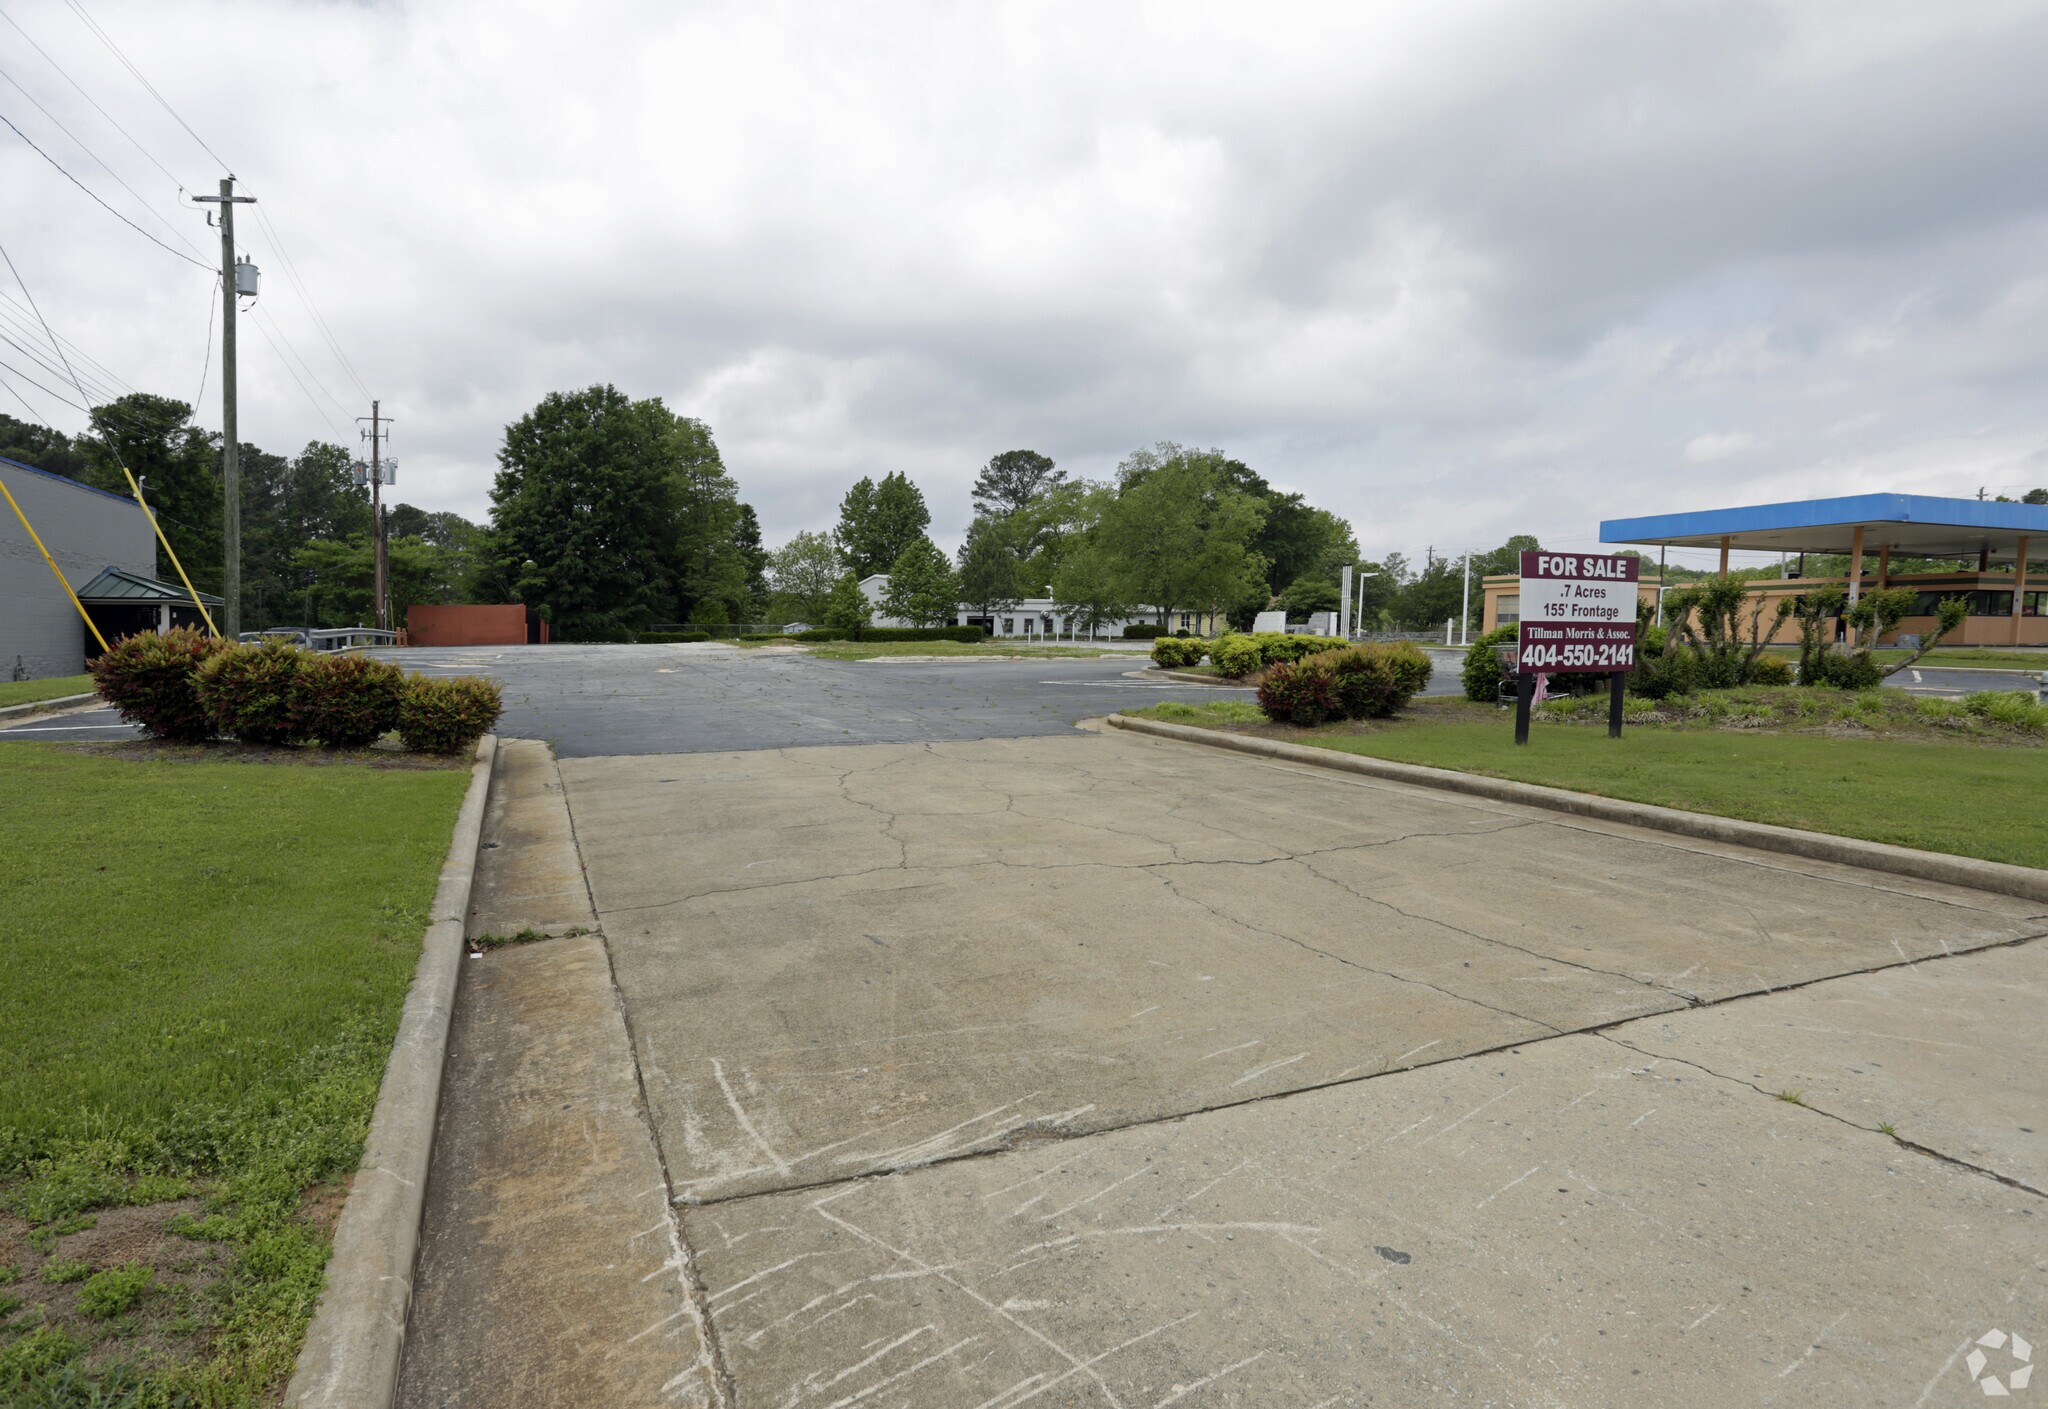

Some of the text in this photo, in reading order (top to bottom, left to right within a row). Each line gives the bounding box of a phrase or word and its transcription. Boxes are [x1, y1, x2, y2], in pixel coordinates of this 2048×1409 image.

[1538, 556, 1627, 578] FOR SALE
[1561, 585, 1606, 598] .7 Acres
[1544, 603, 1618, 620] 155' Frontage
[1528, 627, 1630, 639] Tillman Morris & Assoc.
[1522, 644, 1633, 666] 404-550-2141
